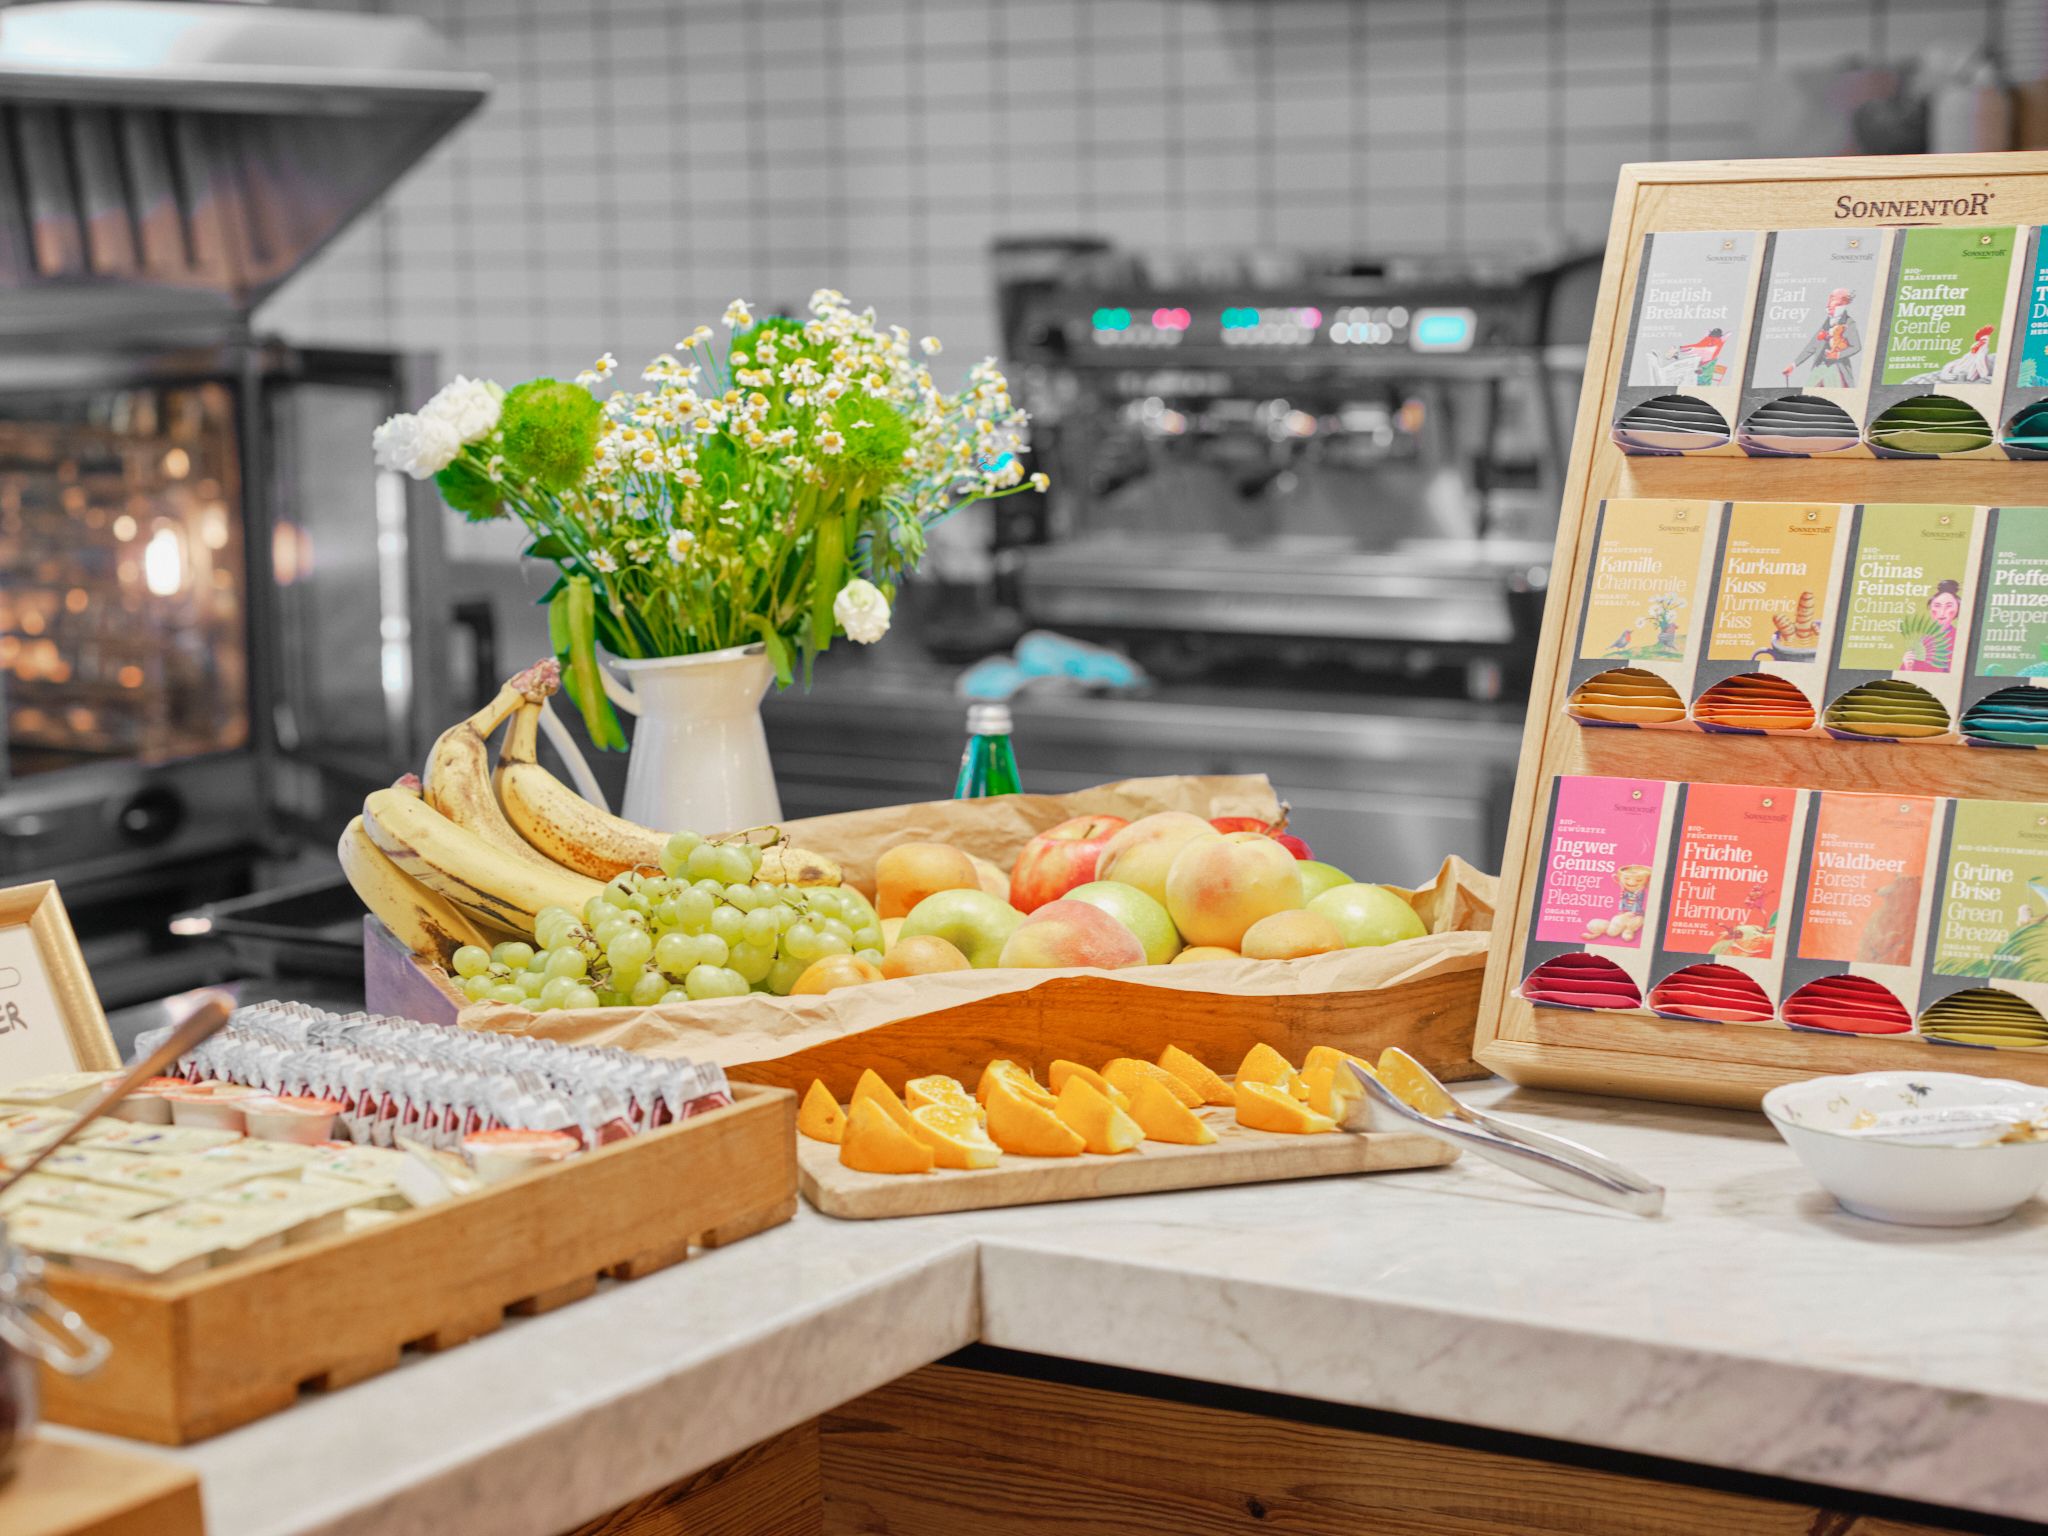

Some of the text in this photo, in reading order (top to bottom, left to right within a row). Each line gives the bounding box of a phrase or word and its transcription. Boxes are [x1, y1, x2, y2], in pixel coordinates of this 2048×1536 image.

[1835, 193, 1989, 219] SONNENTOR
[1648, 287, 1712, 306] English
[1772, 287, 1807, 303] Earl
[1900, 284, 1969, 300] Sanfter
[1645, 304, 1728, 320] Breakfast
[1769, 305, 1810, 323] Grey
[1897, 303, 1966, 320] Morgen
[1894, 318, 1951, 334] Gentle
[1892, 335, 1964, 354] Morning
[1600, 556, 1663, 573] Kamille
[1727, 557, 1807, 576] Kurkuma
[1860, 561, 1924, 579] Chinas
[1597, 573, 1688, 592] Chamomile
[1724, 576, 1767, 594] Kuss
[1856, 580, 1931, 597] Feinster
[1722, 594, 1796, 612] Turmeric
[1719, 611, 1752, 629] Kiss
[1851, 615, 1904, 633] Finest
[1986, 627, 2028, 642] mint
[1555, 837, 1617, 857] Ingwer
[1683, 842, 1752, 863] Früchte
[1552, 854, 1616, 873] Genuss
[1680, 860, 1768, 883] Harmonie
[1818, 852, 1906, 873] Waldbeer
[1953, 861, 2014, 883] Grüne
[1550, 870, 1603, 892] Ginger
[1814, 870, 1868, 889] Forest
[1547, 888, 1614, 908] Pleasure
[1678, 881, 1717, 901] Fruit
[1812, 888, 1872, 907] Berries
[1951, 880, 2002, 901] Brise
[1675, 899, 1752, 924] Harmony
[1948, 902, 2003, 924] Green
[1945, 921, 2010, 944] Breeze
